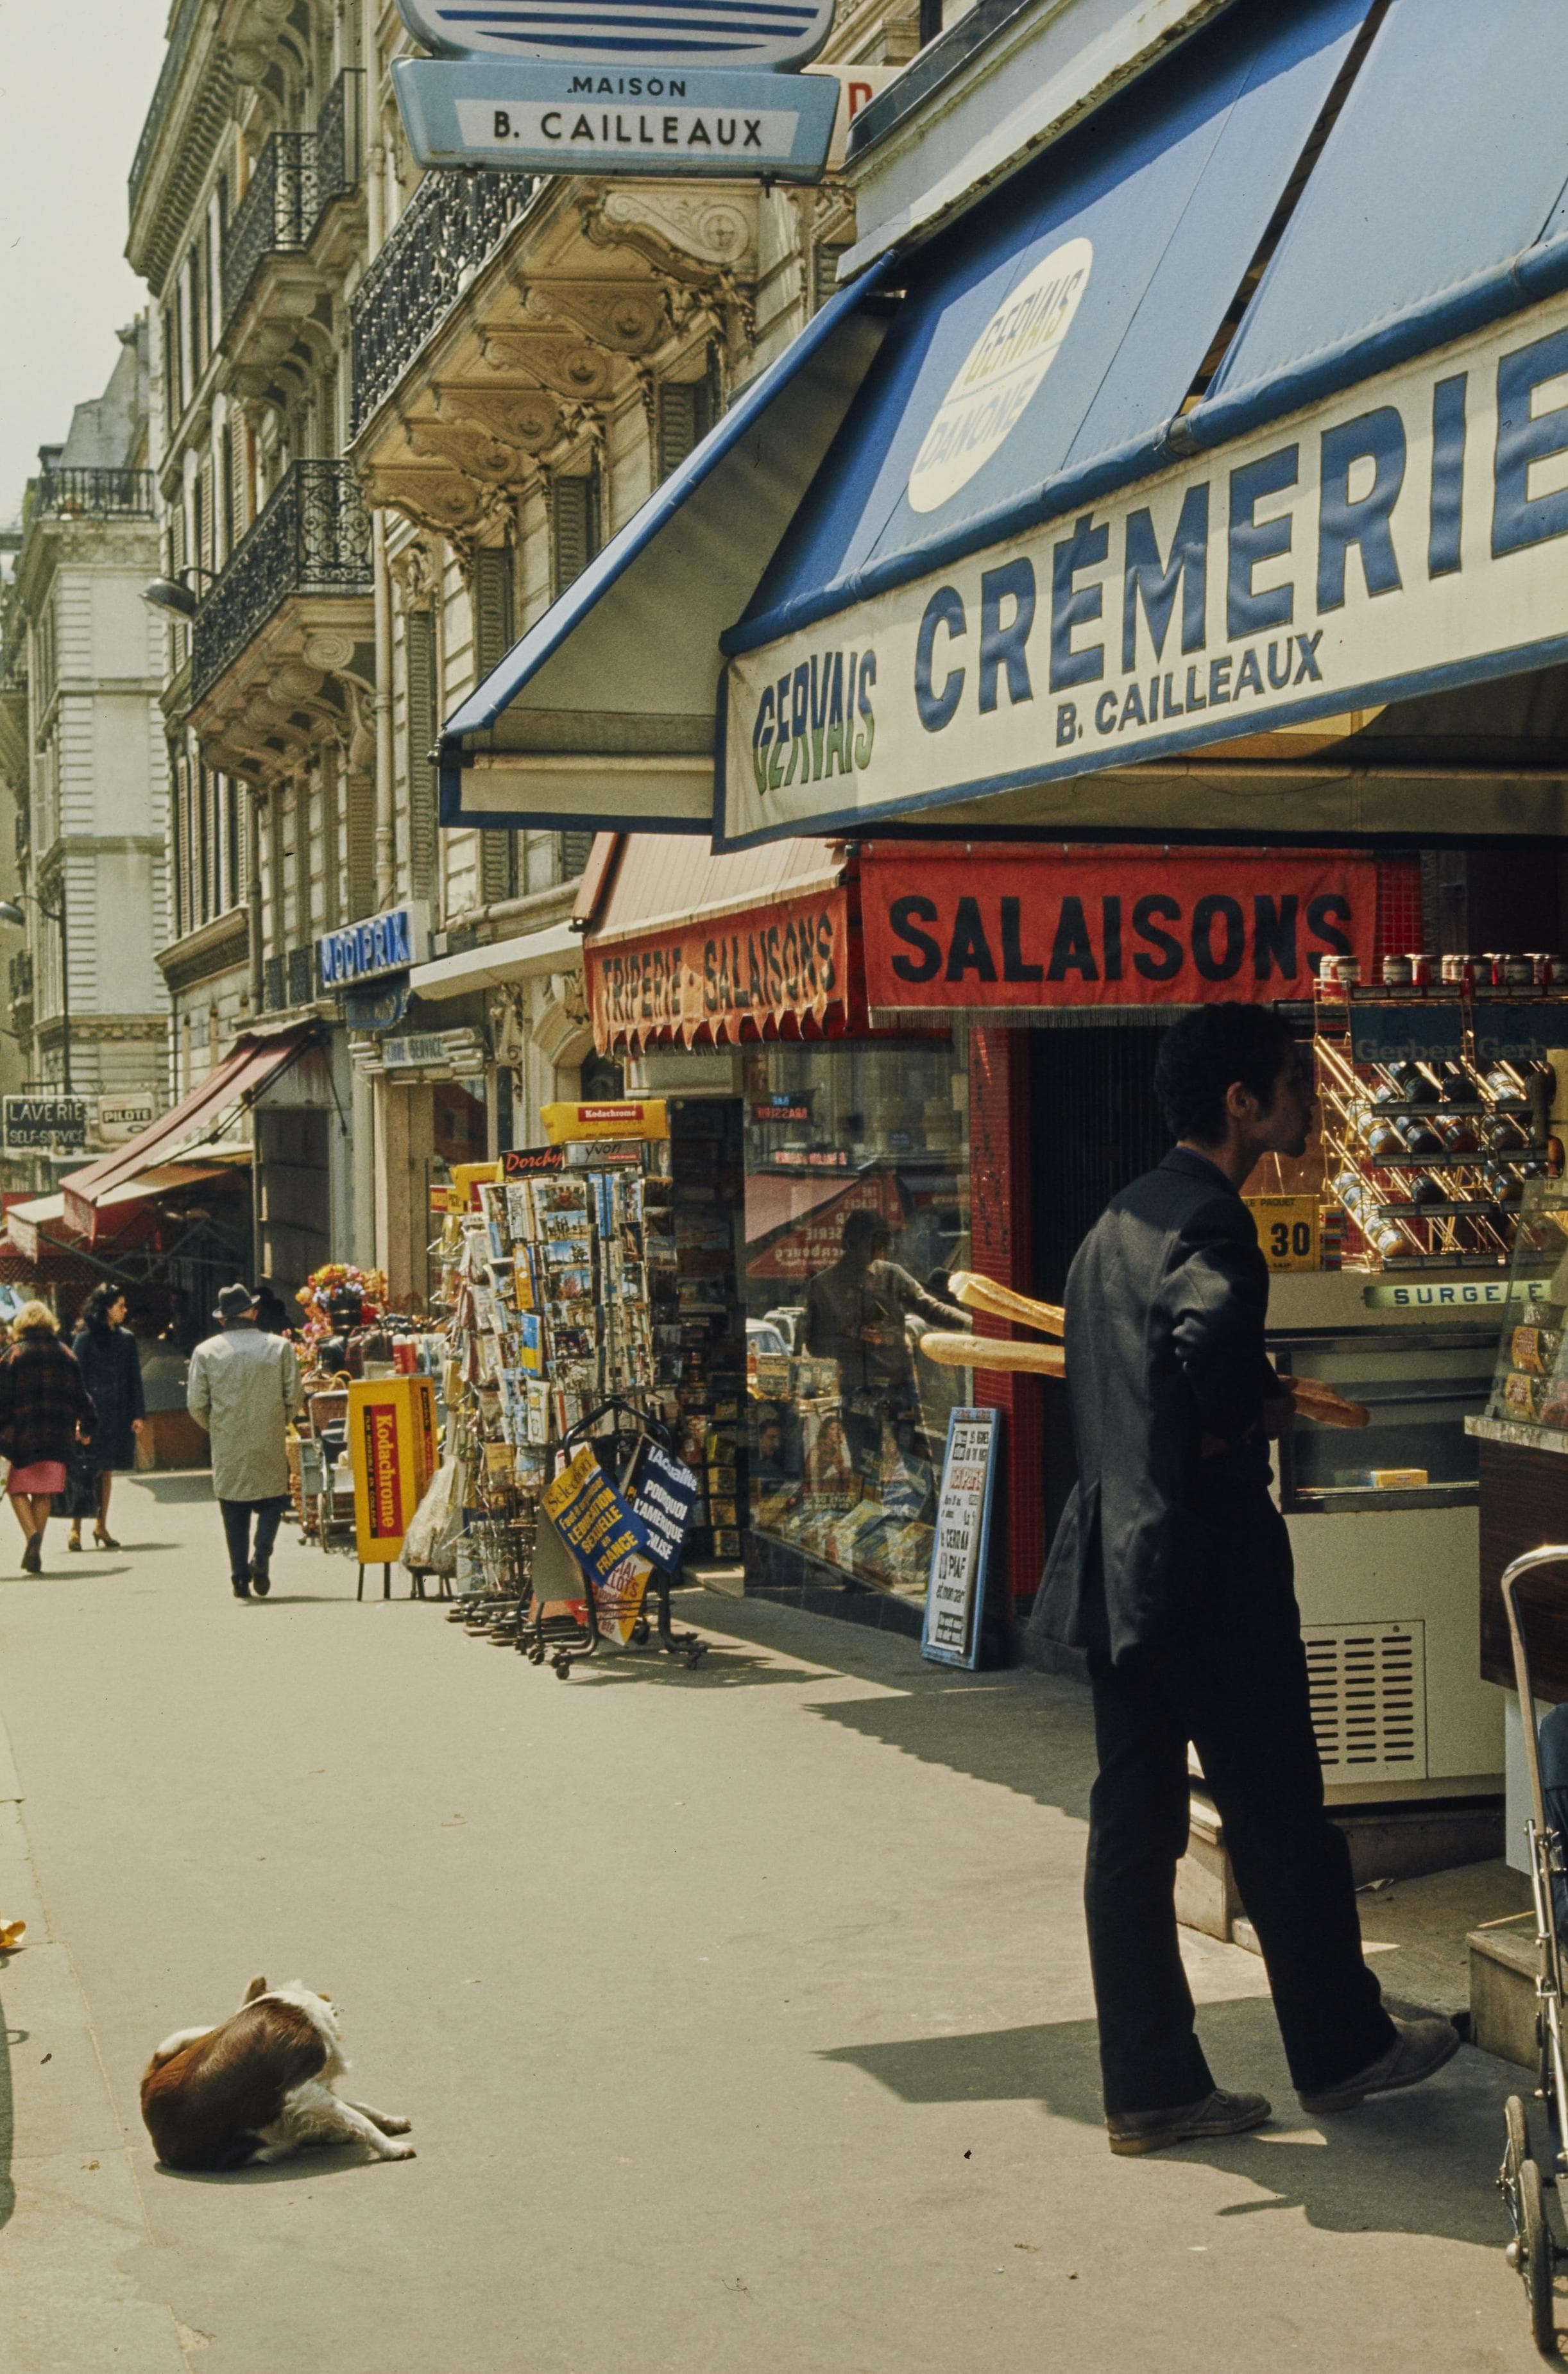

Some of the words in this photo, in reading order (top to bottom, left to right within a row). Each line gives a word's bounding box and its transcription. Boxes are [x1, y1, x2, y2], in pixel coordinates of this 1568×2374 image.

[573, 76, 686, 98] MAISON
[494, 111, 520, 138] B.
[541, 112, 762, 148] CAILLEAUX
[964, 268, 1086, 386] GERVAIS
[913, 371, 1039, 475] DANONE
[913, 326, 1568, 734] CRÉMERIE
[1056, 701, 1083, 748] B.
[1095, 629, 1323, 735] CAILLEAUX
[751, 649, 878, 798] GERVAIS
[890, 894, 1354, 984] SALAISONS
[602, 946, 681, 1023] TRIPERIE
[705, 905, 835, 1012] SALAISONS
[1355, 1038, 1460, 1060] Gerber
[1478, 1036, 1547, 1060] Gerb
[10, 1103, 83, 1122] LAVERIE
[104, 1111, 150, 1122] PILOTE
[585, 1109, 636, 1119] Kodachrome
[586, 1143, 622, 1163] yvon
[1270, 1222, 1310, 1257] 30
[376, 1414, 395, 1528] Kodachrome
[644, 1480, 688, 1521] POURQUOI
[596, 1530, 638, 1575] FRANCE
